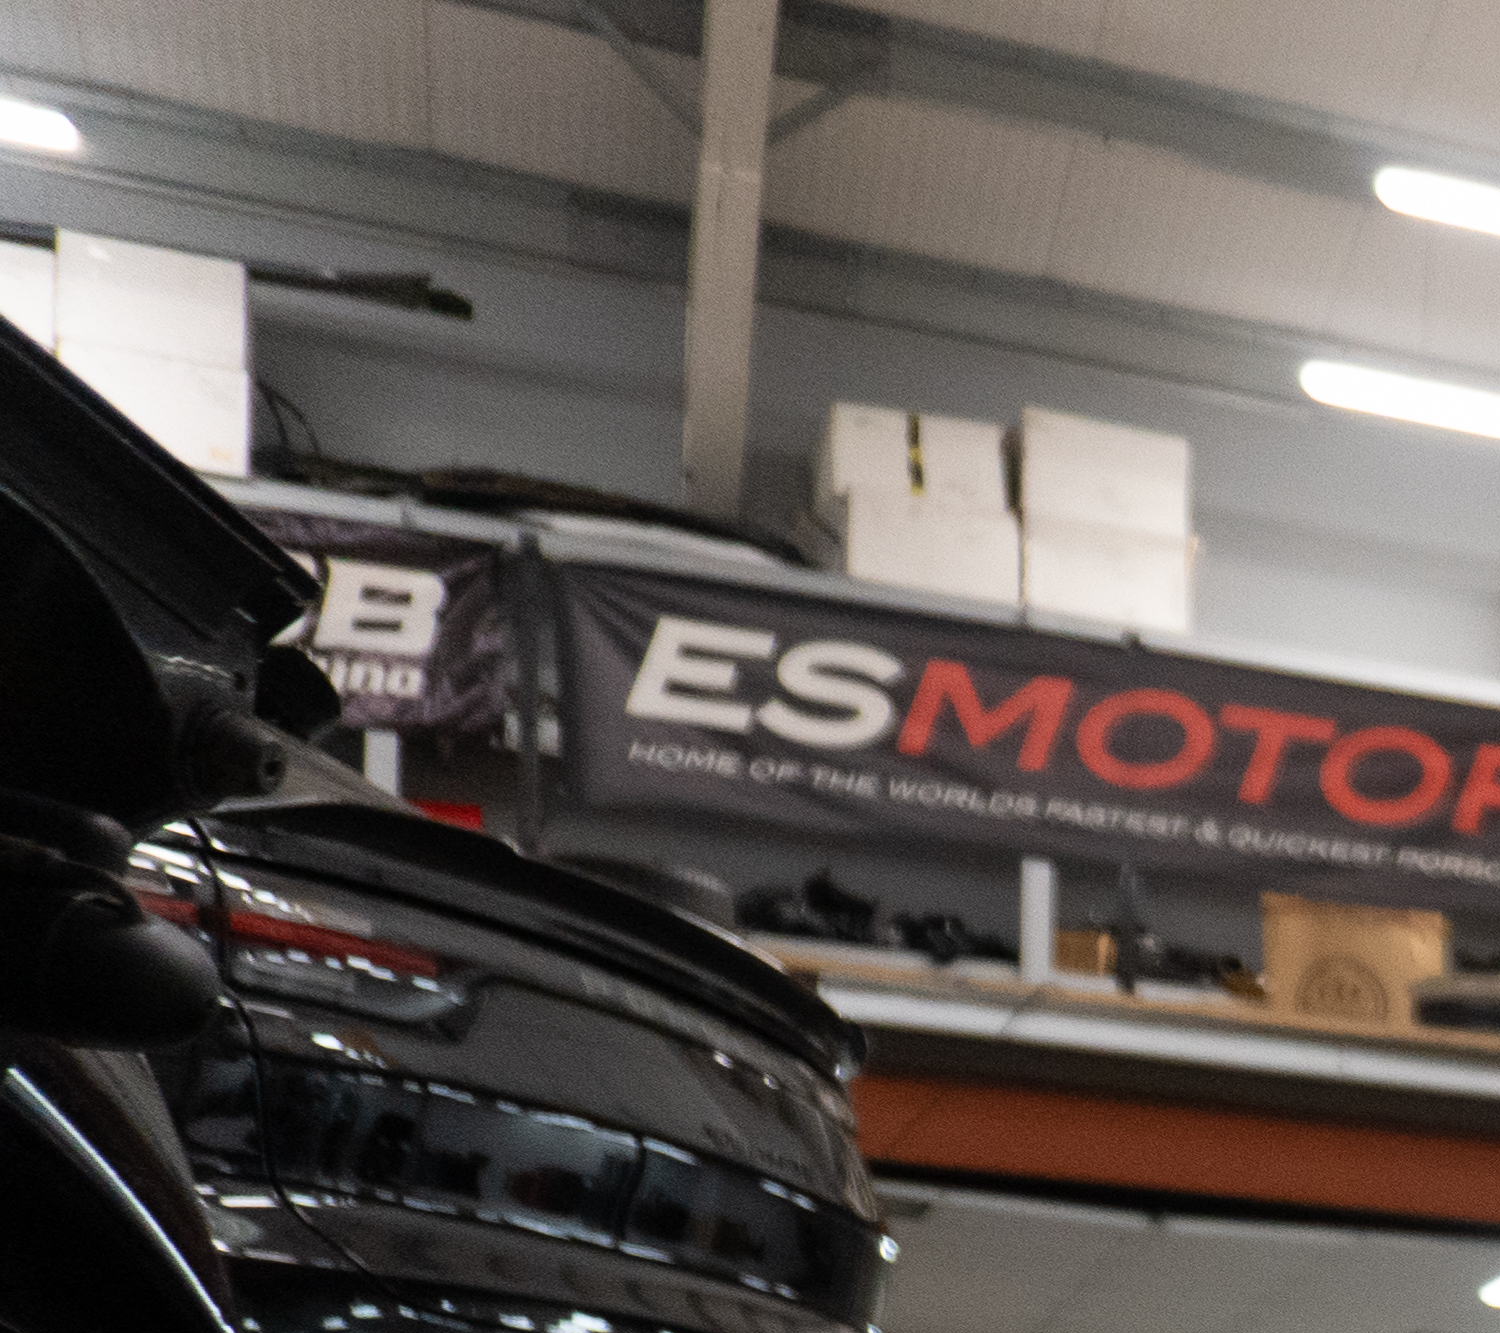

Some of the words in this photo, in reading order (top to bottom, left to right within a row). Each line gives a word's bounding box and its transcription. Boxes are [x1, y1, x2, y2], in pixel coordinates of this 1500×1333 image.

[629, 741, 741, 778] HOME
[749, 757, 799, 784] OF
[812, 766, 879, 798] THE
[889, 777, 1038, 818] WORLDS
[1046, 797, 1191, 836] FASTEST
[1228, 822, 1392, 865] QUICKEST
